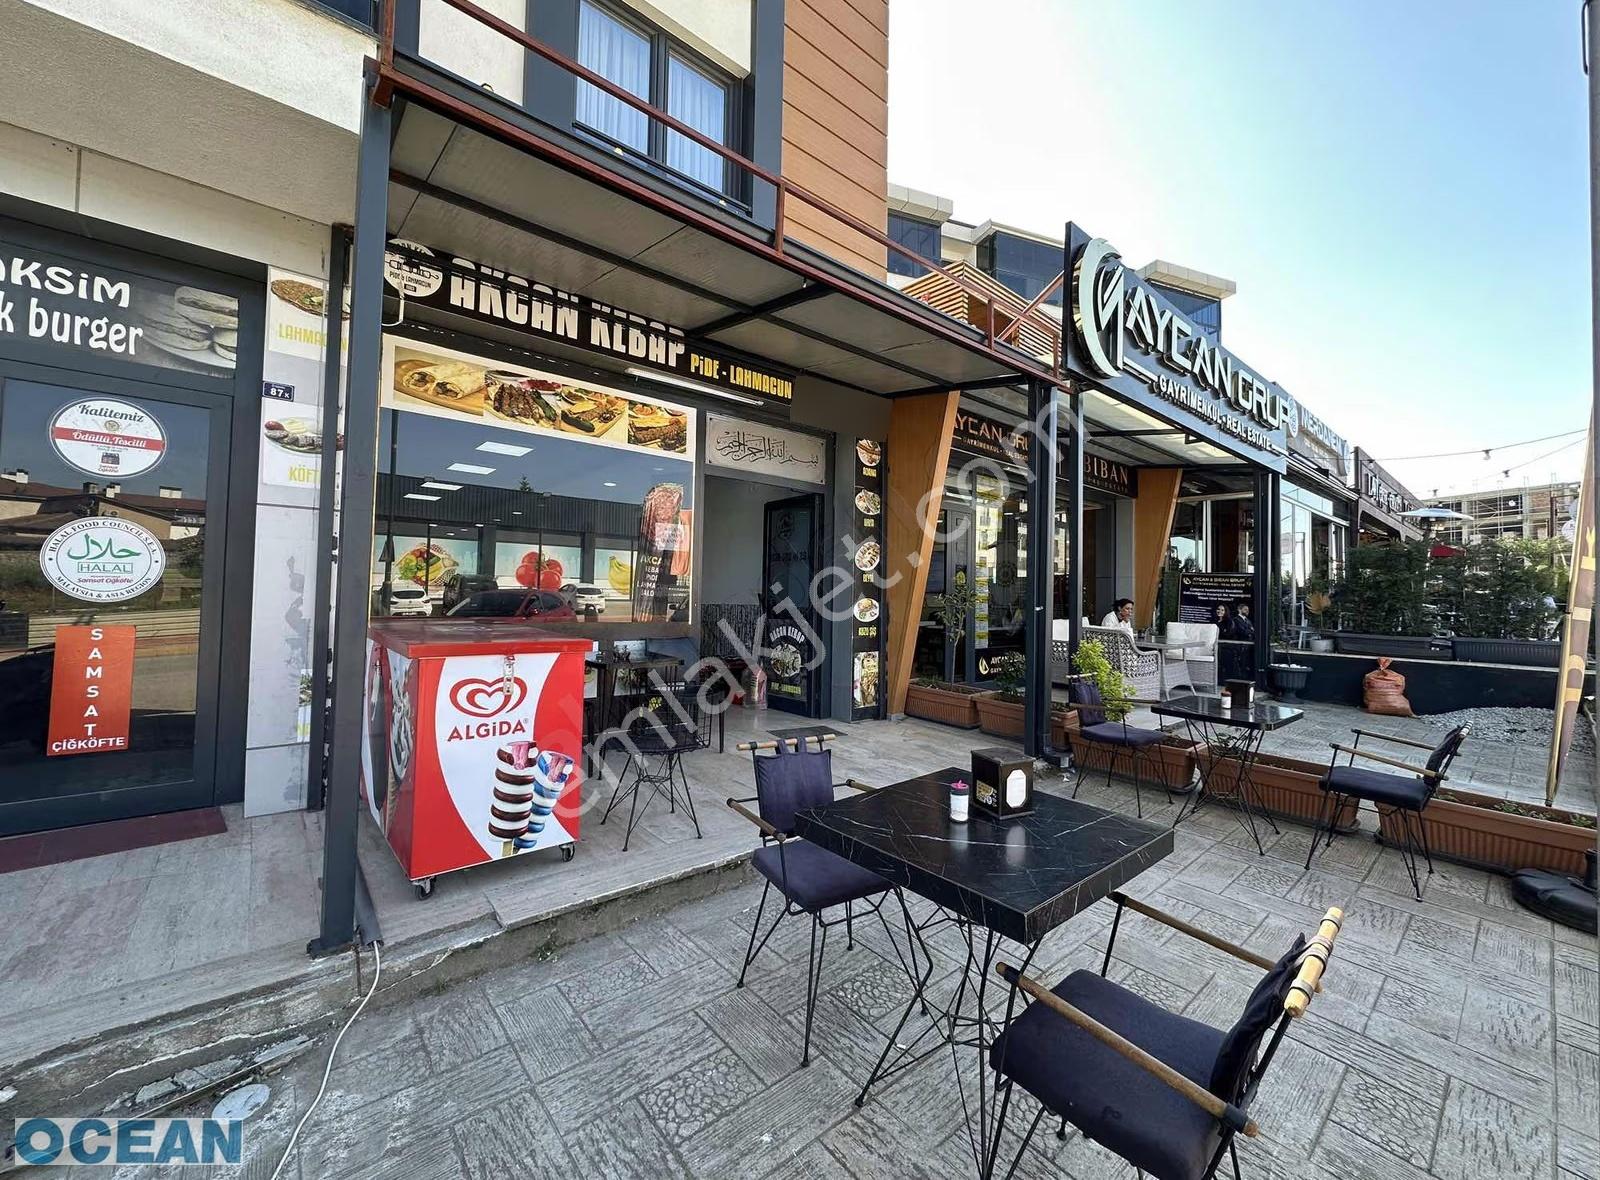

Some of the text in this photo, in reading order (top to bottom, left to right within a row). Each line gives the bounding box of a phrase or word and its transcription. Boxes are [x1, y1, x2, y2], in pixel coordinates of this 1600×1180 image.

[29, 297, 143, 355] burger
[1125, 286, 1232, 398] AYCAN
[730, 365, 792, 399] LAHMACUN
[79, 404, 144, 423] Kalitemiz
[112, 436, 147, 448] Tescilli
[1226, 414, 1247, 437] REAL
[1247, 427, 1272, 450] ESTATE
[288, 464, 321, 484] KÖFT
[48, 530, 72, 552] HALAL
[71, 520, 99, 533] FOOD
[102, 520, 142, 537] COUNCIL
[80, 564, 131, 573] HALAL
[55, 575, 95, 598] MALAYSIA
[104, 591, 125, 599] ASIA
[126, 577, 152, 595] REGION
[52, 736, 125, 752] ÇİĞKÖFTE
